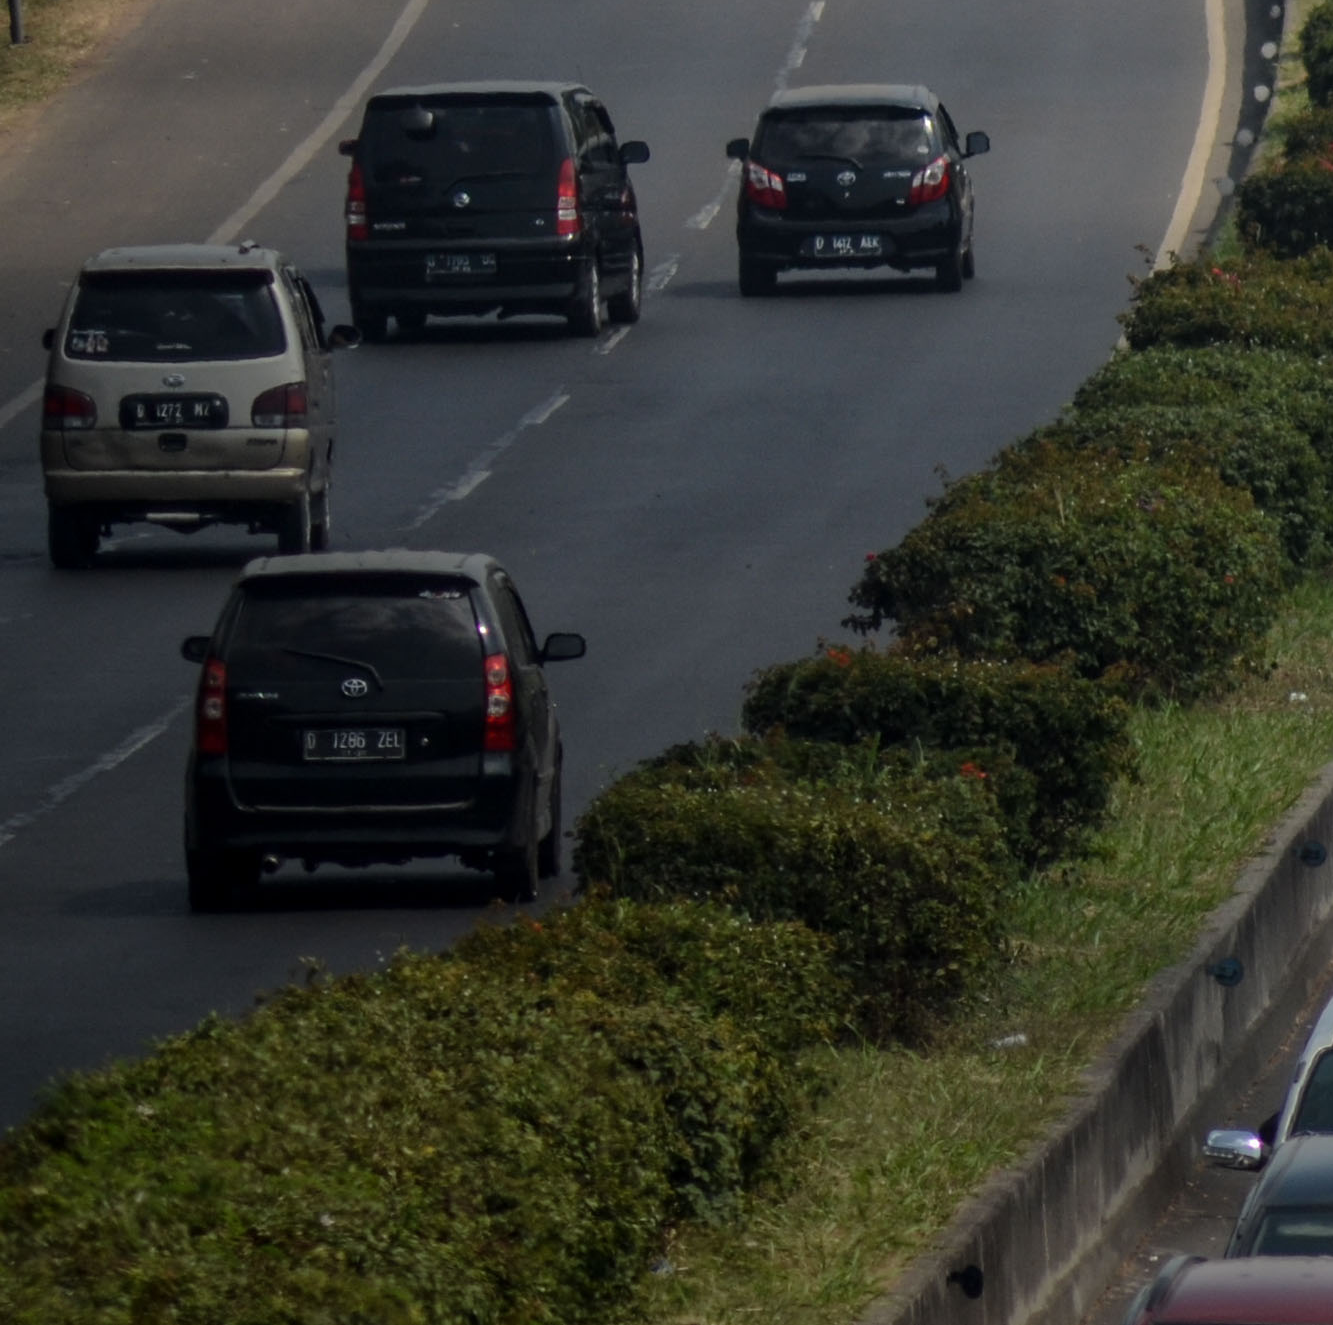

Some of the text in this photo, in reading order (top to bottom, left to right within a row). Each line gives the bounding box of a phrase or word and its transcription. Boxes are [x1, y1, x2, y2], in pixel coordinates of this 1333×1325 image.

[155, 403, 182, 418] 1272
[307, 732, 316, 749] D
[377, 731, 401, 749] ZEL
